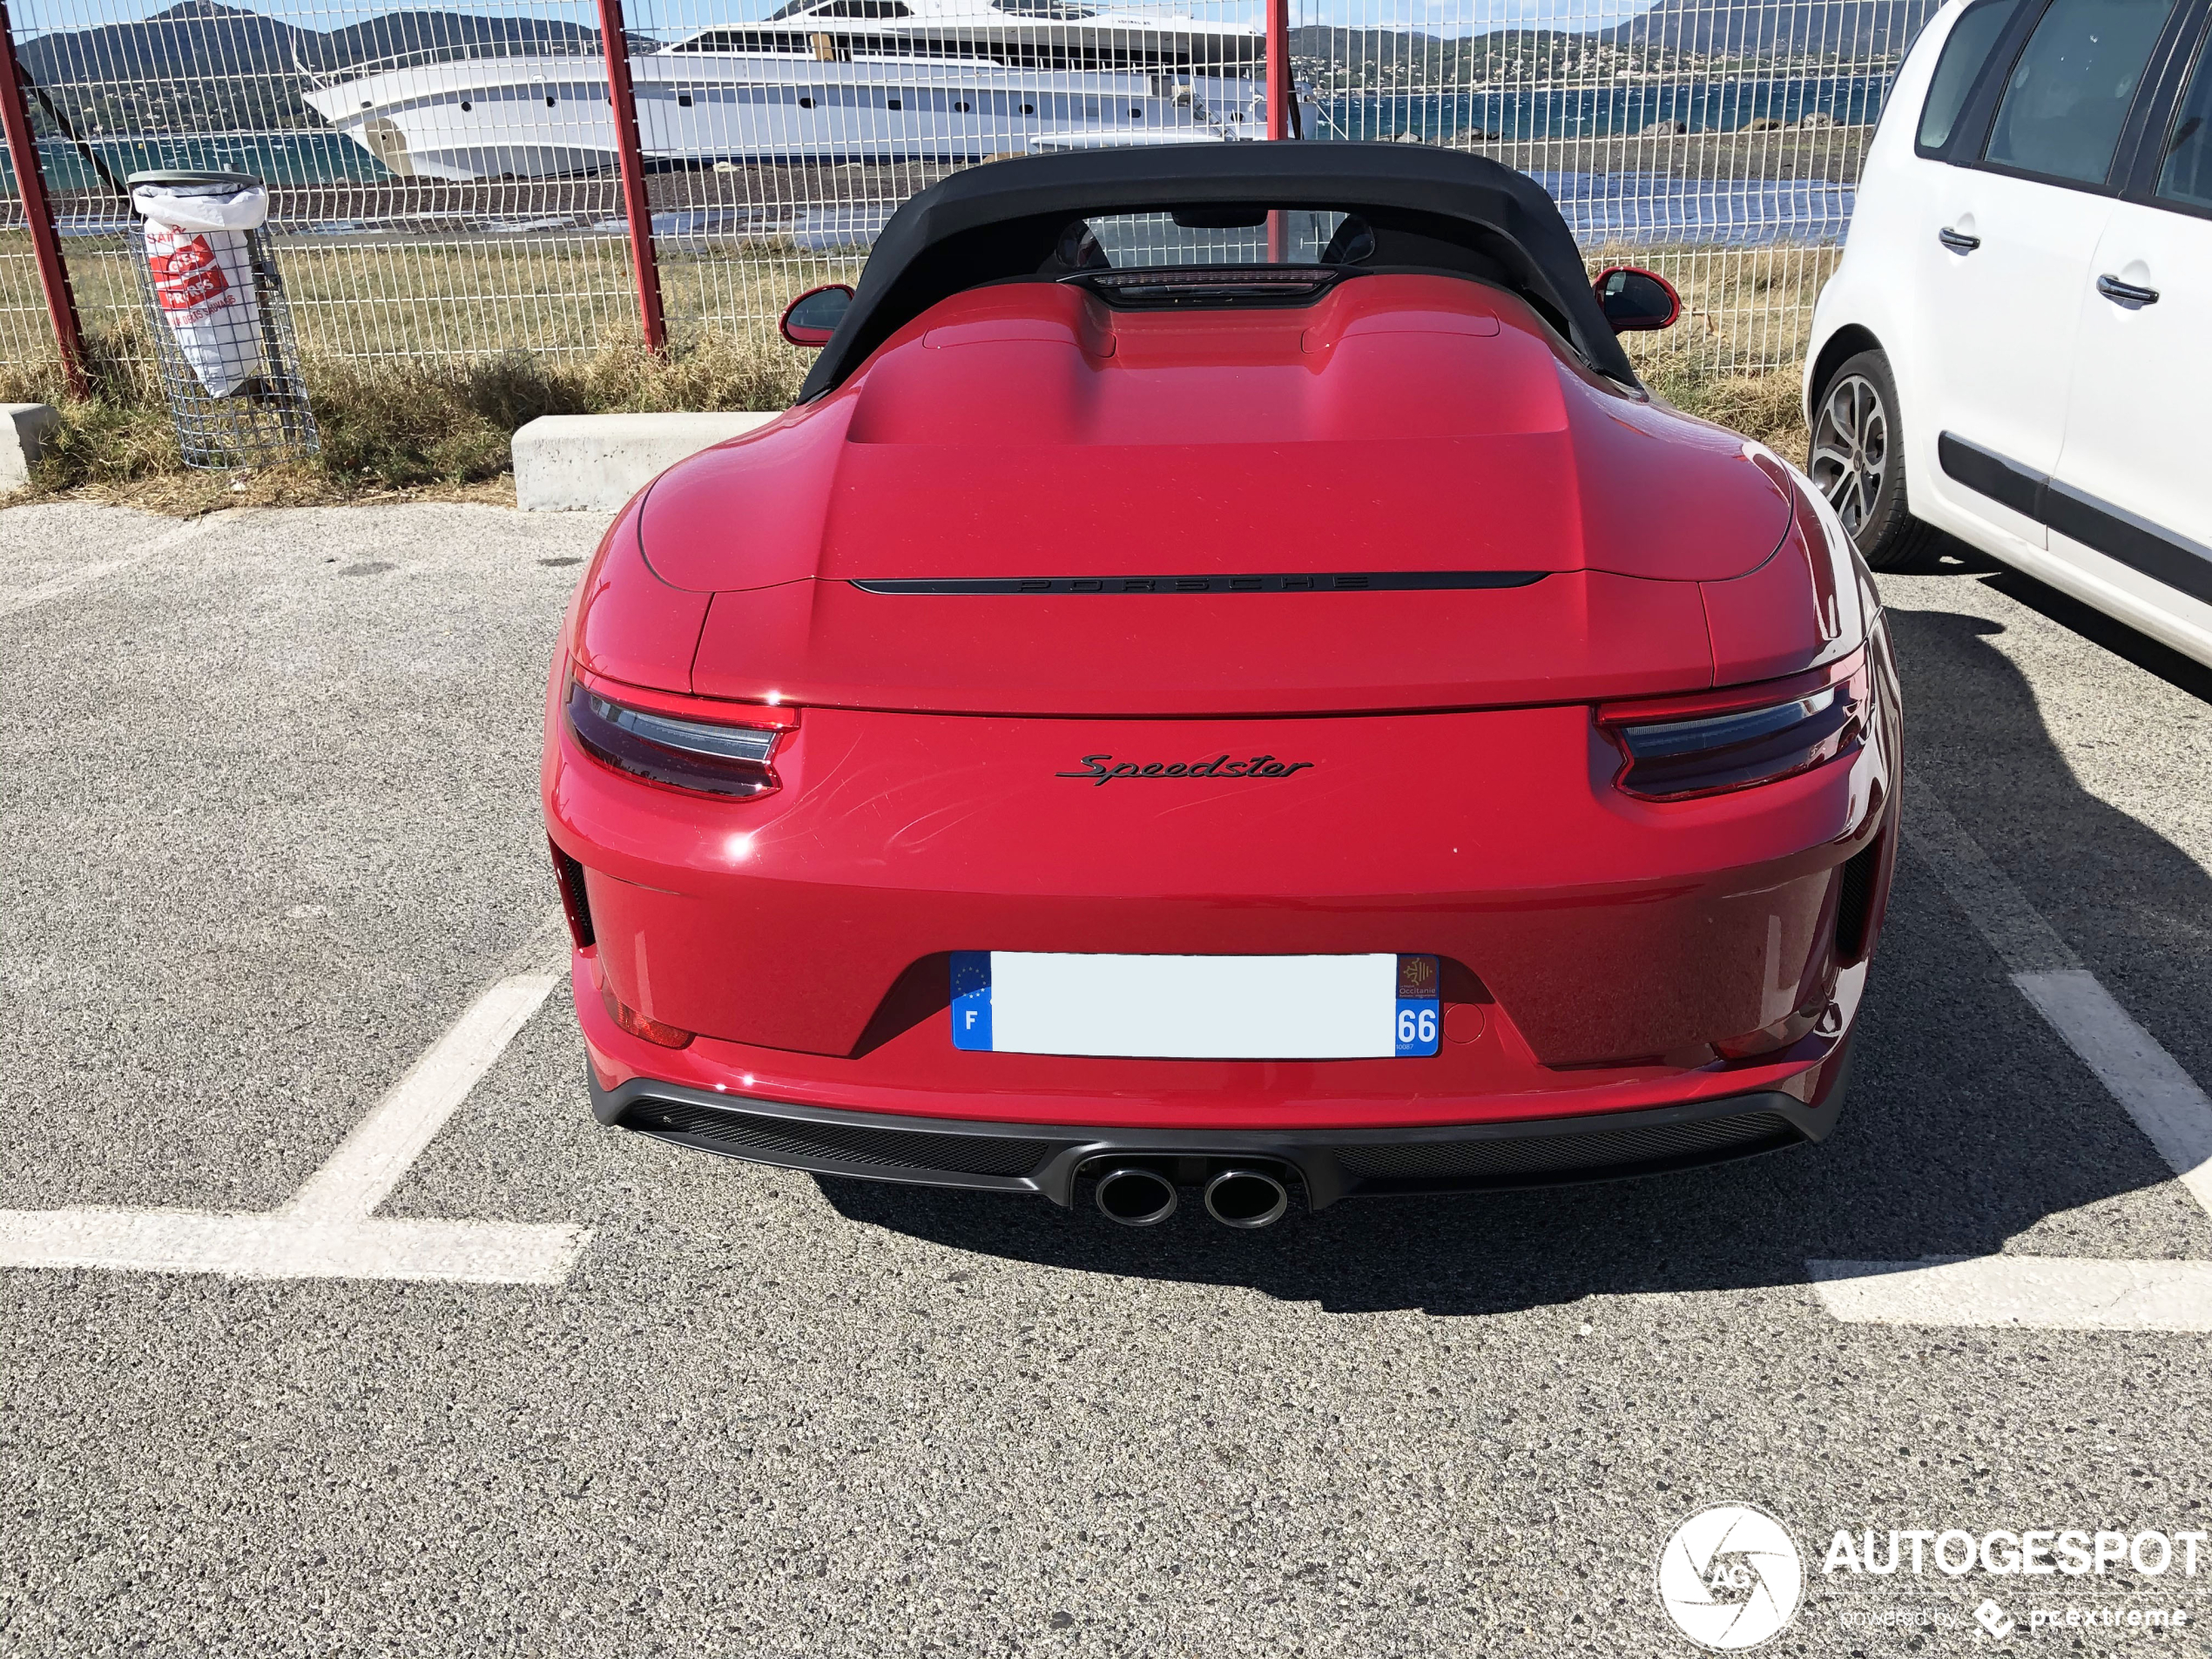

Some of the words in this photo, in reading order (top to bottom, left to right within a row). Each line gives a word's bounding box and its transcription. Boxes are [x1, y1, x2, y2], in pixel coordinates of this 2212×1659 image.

[1016, 576, 1369, 592] PORSCHE
[1054, 754, 1315, 786] Speedster
[965, 1010, 978, 1030] F
[1398, 1009, 1436, 1043] 66
